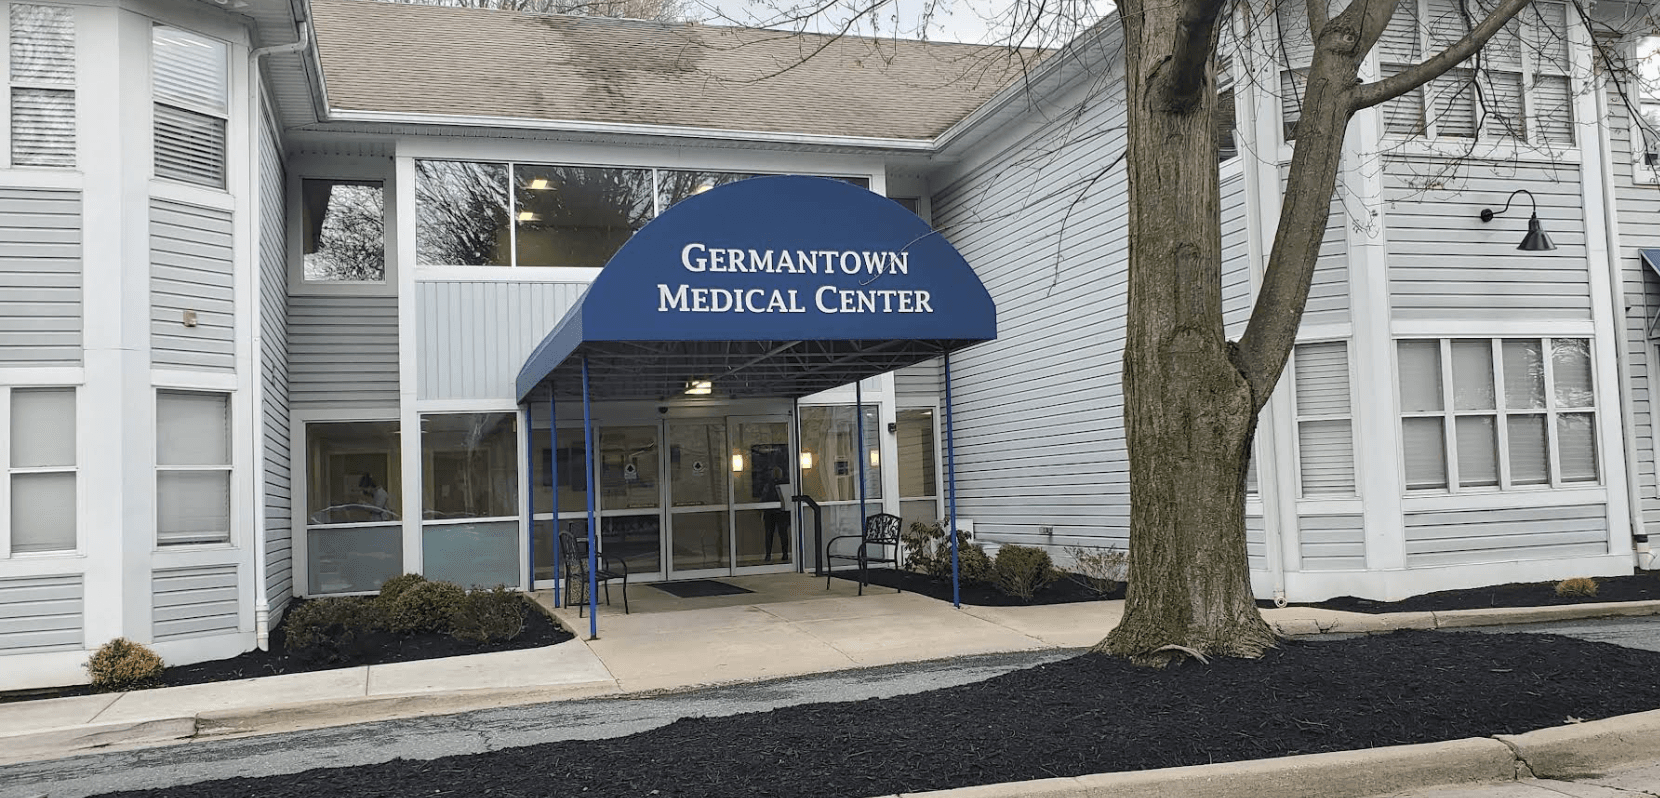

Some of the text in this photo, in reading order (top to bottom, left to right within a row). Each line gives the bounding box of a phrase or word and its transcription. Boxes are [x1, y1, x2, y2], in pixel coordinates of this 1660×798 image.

[681, 243, 909, 275] GERMANTOWN
[657, 283, 934, 314] MEDICAL CENTER
